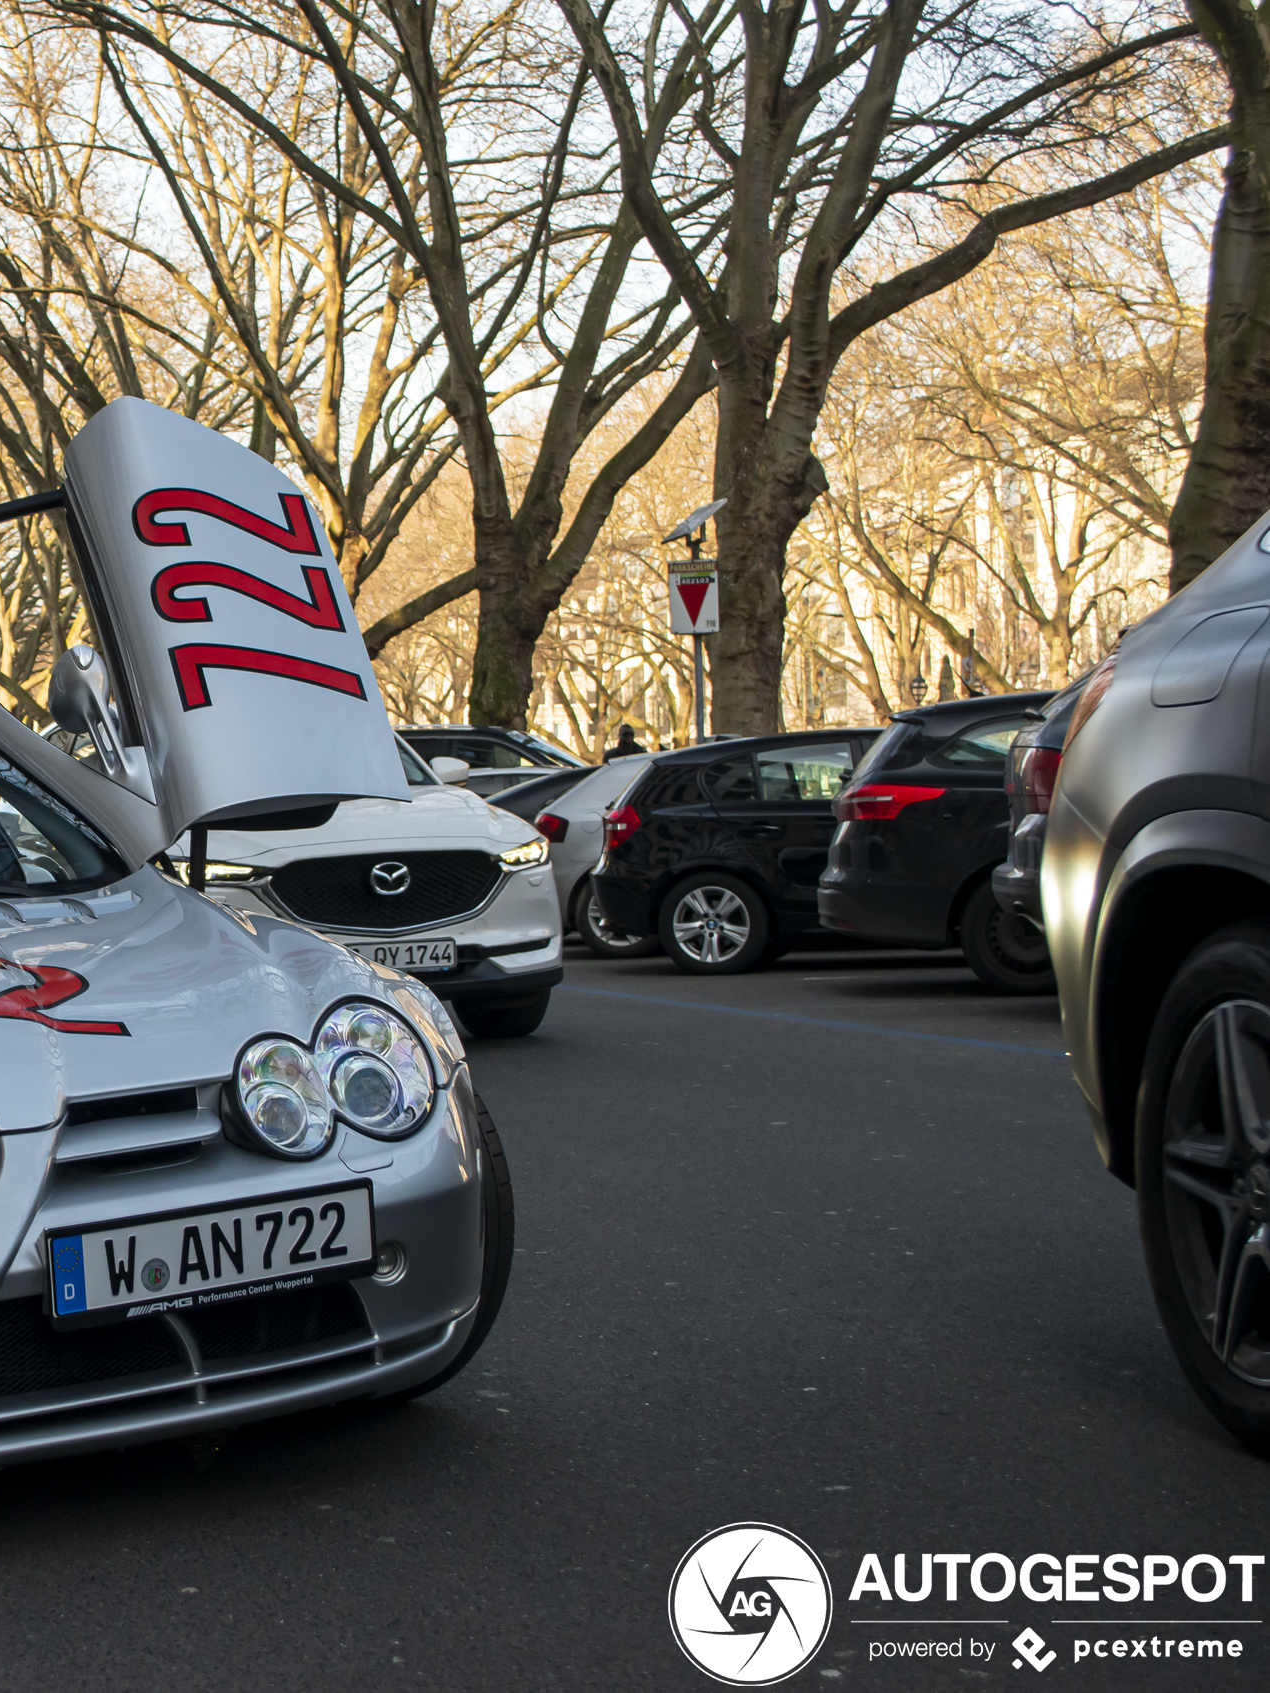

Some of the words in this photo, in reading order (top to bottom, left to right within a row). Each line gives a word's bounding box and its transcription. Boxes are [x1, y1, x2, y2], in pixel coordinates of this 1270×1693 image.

[374, 946, 399, 966] QY
[405, 944, 452, 965] 1744
[104, 1235, 136, 1296] W
[179, 1217, 244, 1285] AN
[255, 1201, 348, 1270] 722
[64, 1283, 76, 1300] D
[198, 1288, 248, 1304] Performance
[248, 1282, 274, 1295] Center
[275, 1275, 314, 1291] Wuppertal
